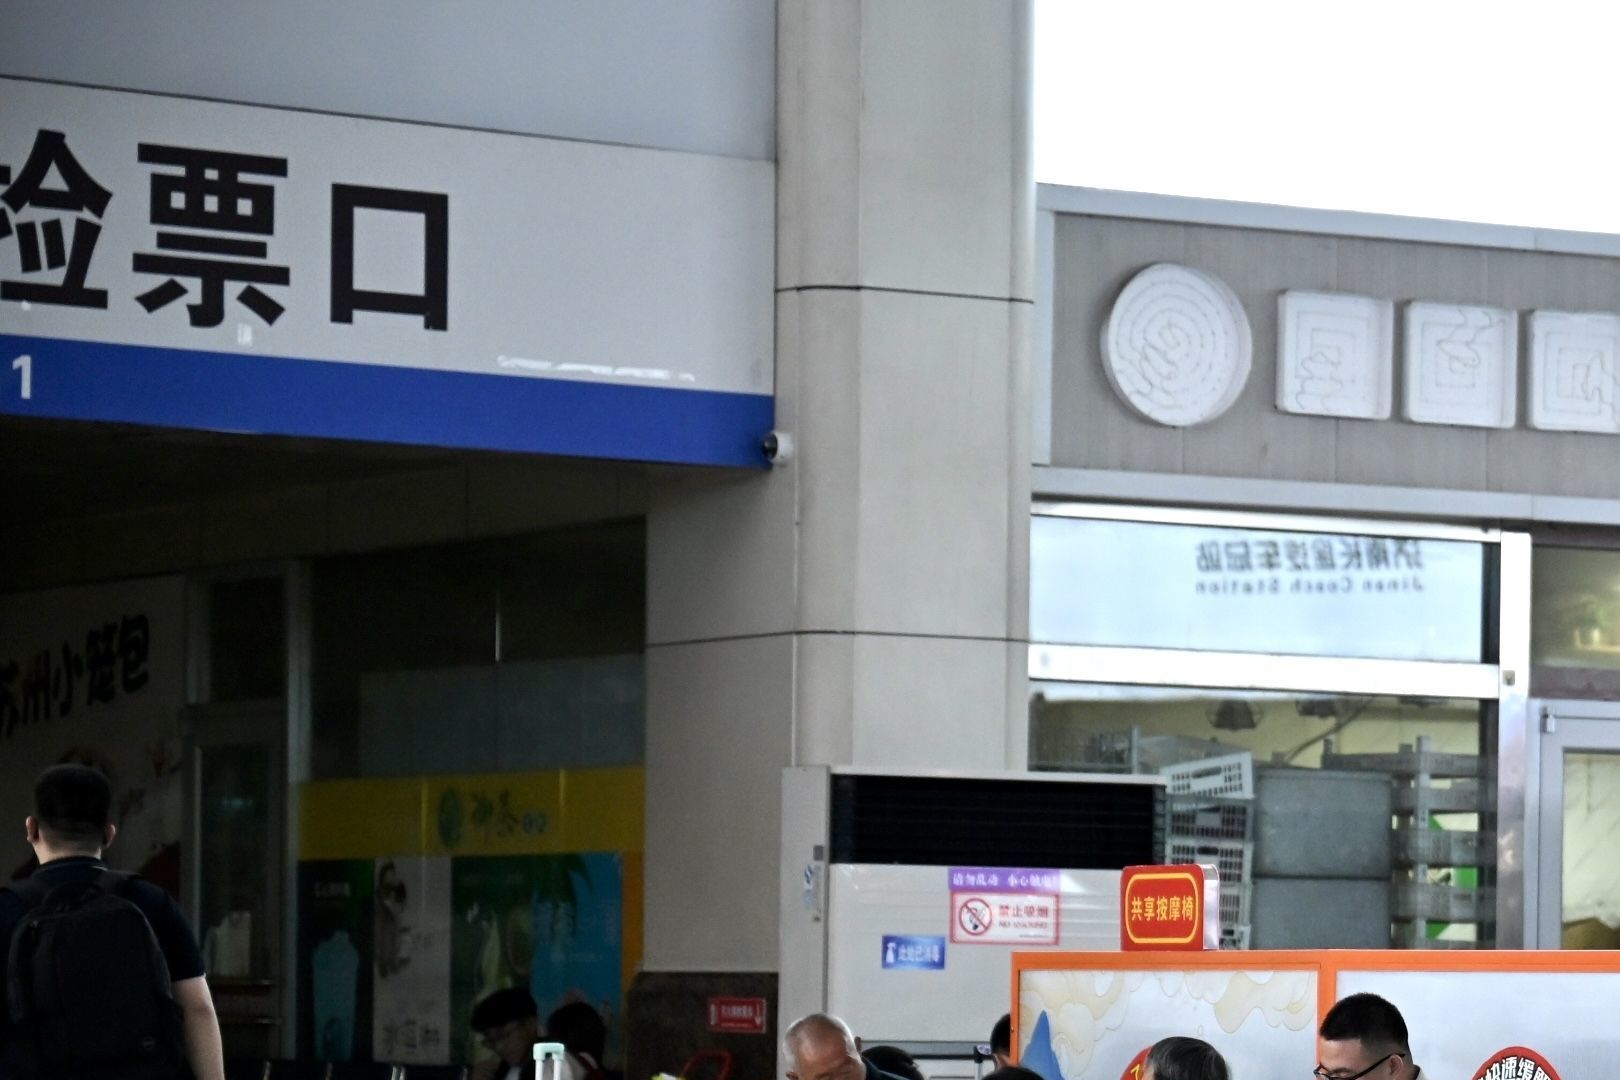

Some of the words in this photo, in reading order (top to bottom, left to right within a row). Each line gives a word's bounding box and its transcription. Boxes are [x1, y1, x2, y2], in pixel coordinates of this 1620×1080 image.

[0, 128, 449, 332] 检票口
[12, 355, 32, 400] 1
[1131, 895, 1194, 922] 共享按摩椅
